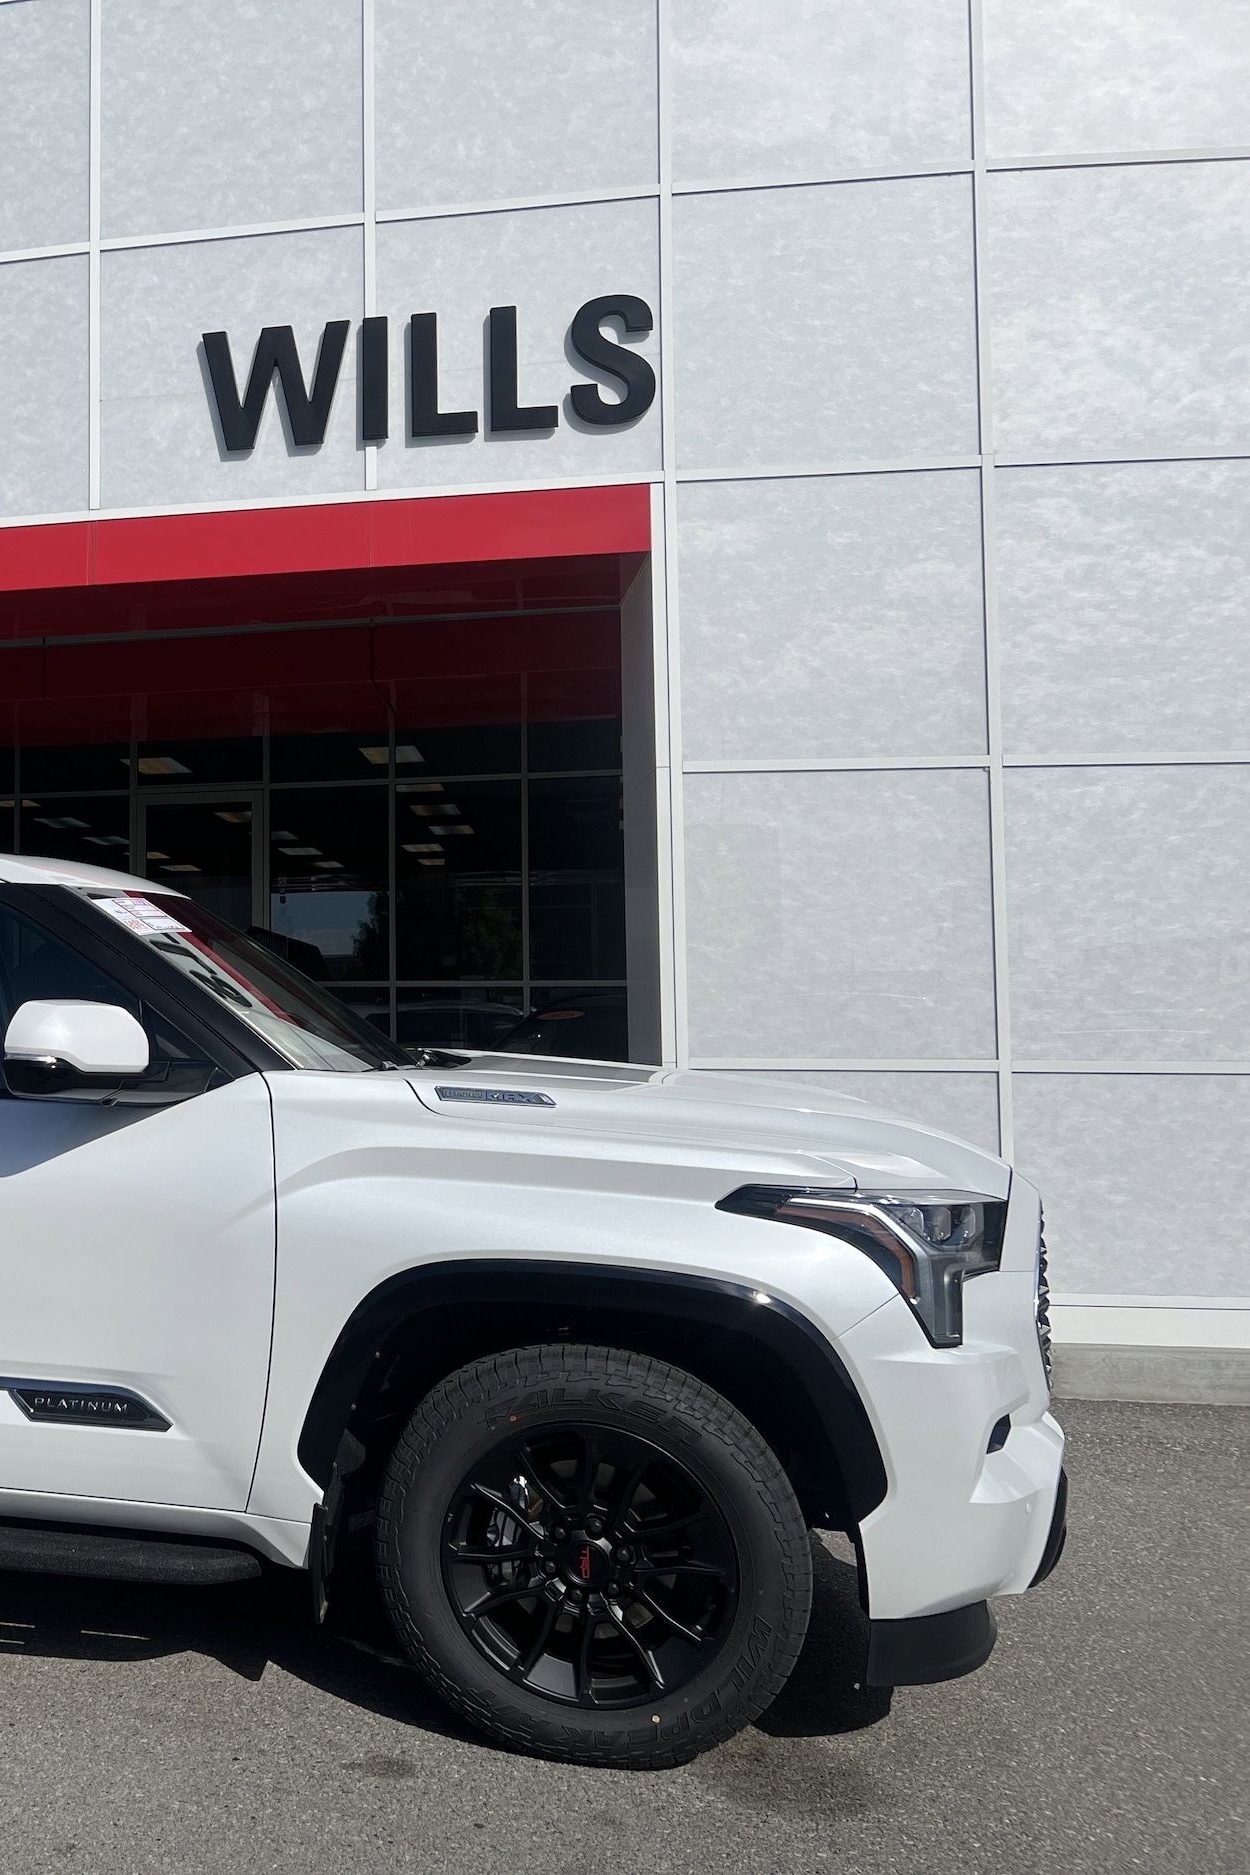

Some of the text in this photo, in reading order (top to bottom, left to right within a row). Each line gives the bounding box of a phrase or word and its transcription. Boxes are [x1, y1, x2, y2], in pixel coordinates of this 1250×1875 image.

[202, 294, 656, 451] WILLS
[34, 1396, 129, 1414] PLATINUM
[483, 1386, 701, 1448] FALKEN
[578, 1546, 591, 1579] TRD
[561, 1614, 774, 1750] WILDPEAK
